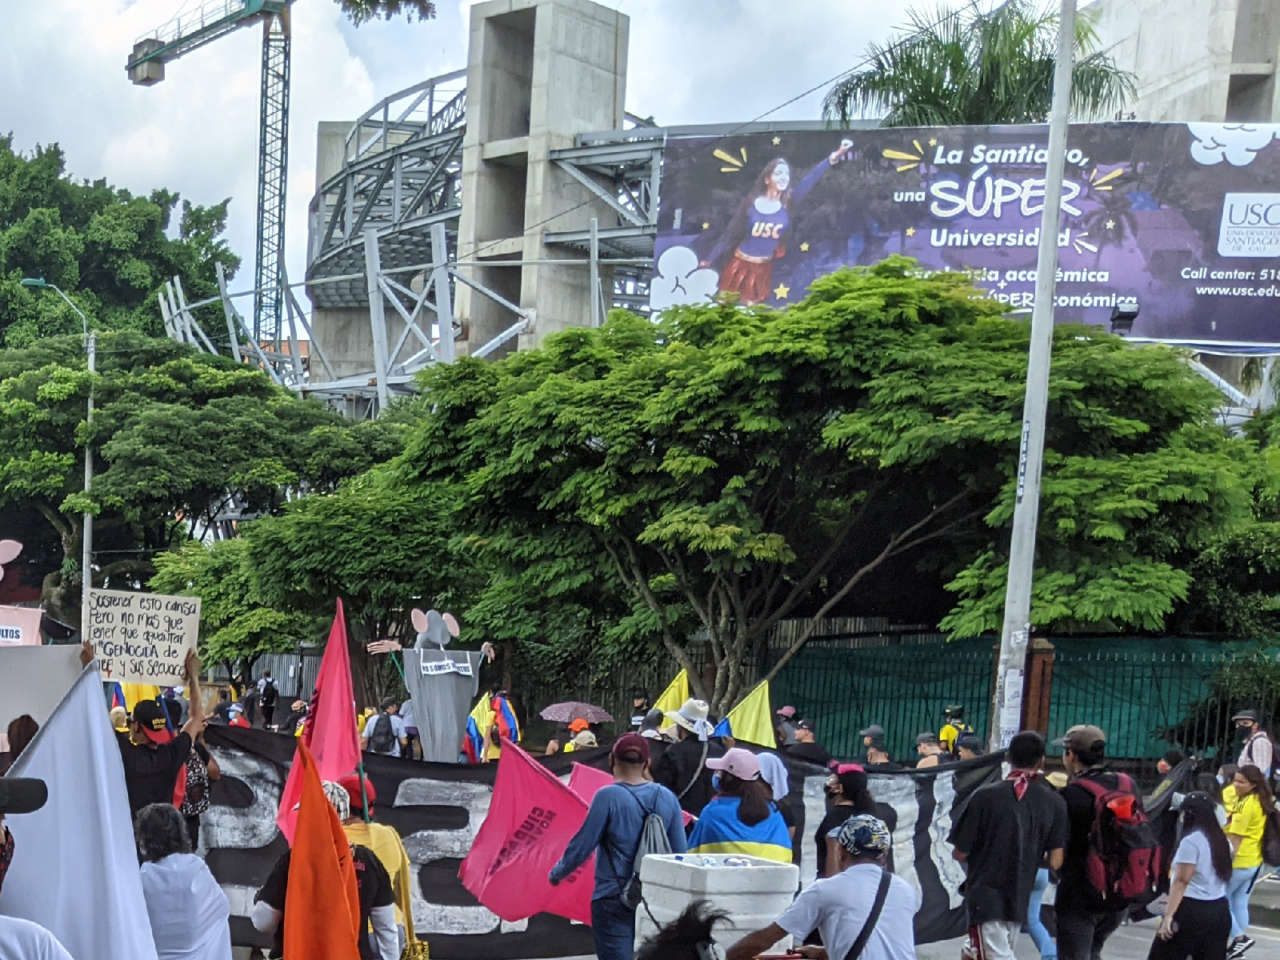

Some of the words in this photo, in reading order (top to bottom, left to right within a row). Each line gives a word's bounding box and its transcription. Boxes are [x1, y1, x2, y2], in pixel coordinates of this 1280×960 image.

[933, 145, 963, 164] La
[970, 144, 1089, 166] Santiao,
[894, 191, 926, 202] una
[930, 165, 1083, 218] SÚPER
[1229, 203, 1280, 226] USC
[751, 221, 784, 239] USC
[930, 228, 1071, 247] Universidd
[1005, 268, 1110, 282] acaémica
[1180, 267, 1208, 280] Call
[1210, 269, 1255, 280] center:
[89, 608, 114, 624] Pero
[121, 612, 134, 625] no
[163, 615, 183, 632] que
[120, 626, 139, 643] que
[163, 645, 179, 658] de
[119, 660, 126, 677] y
